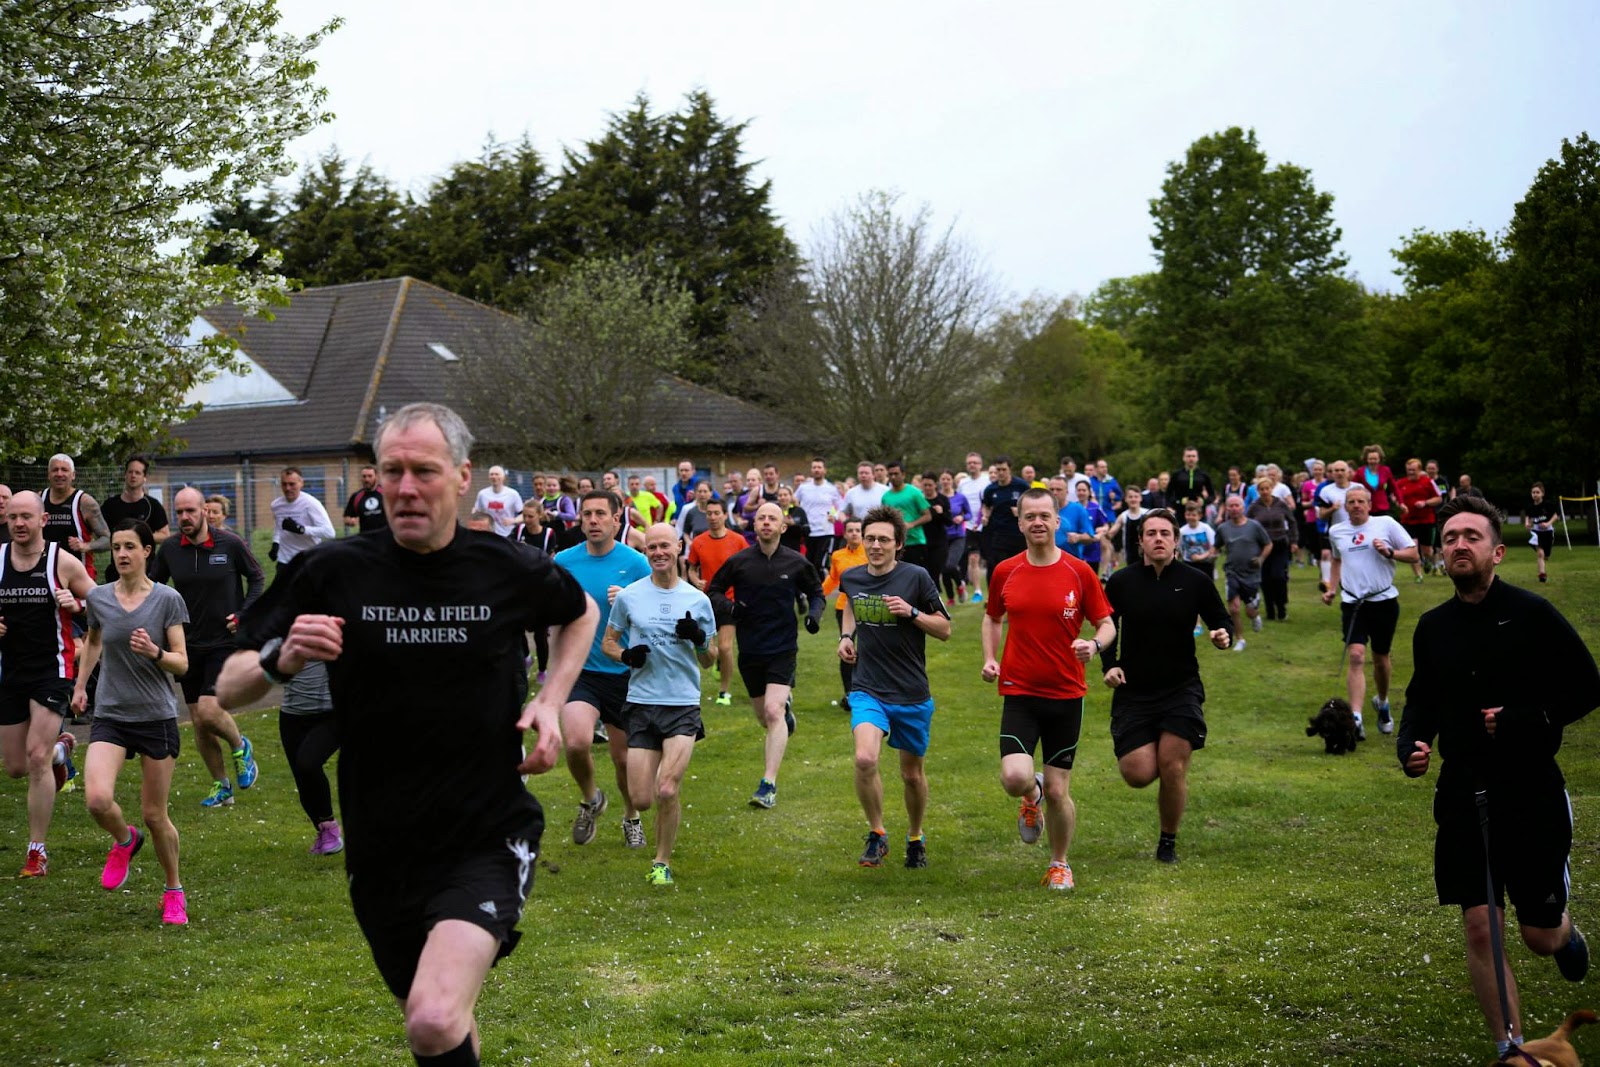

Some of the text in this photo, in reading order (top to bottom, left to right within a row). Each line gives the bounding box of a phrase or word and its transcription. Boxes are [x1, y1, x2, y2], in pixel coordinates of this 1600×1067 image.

[0, 587, 48, 596] DARTFORD
[361, 605, 491, 622] ISTEAD & IFIELD
[854, 604, 898, 623] RUN
[385, 627, 468, 643] HARRIERS
